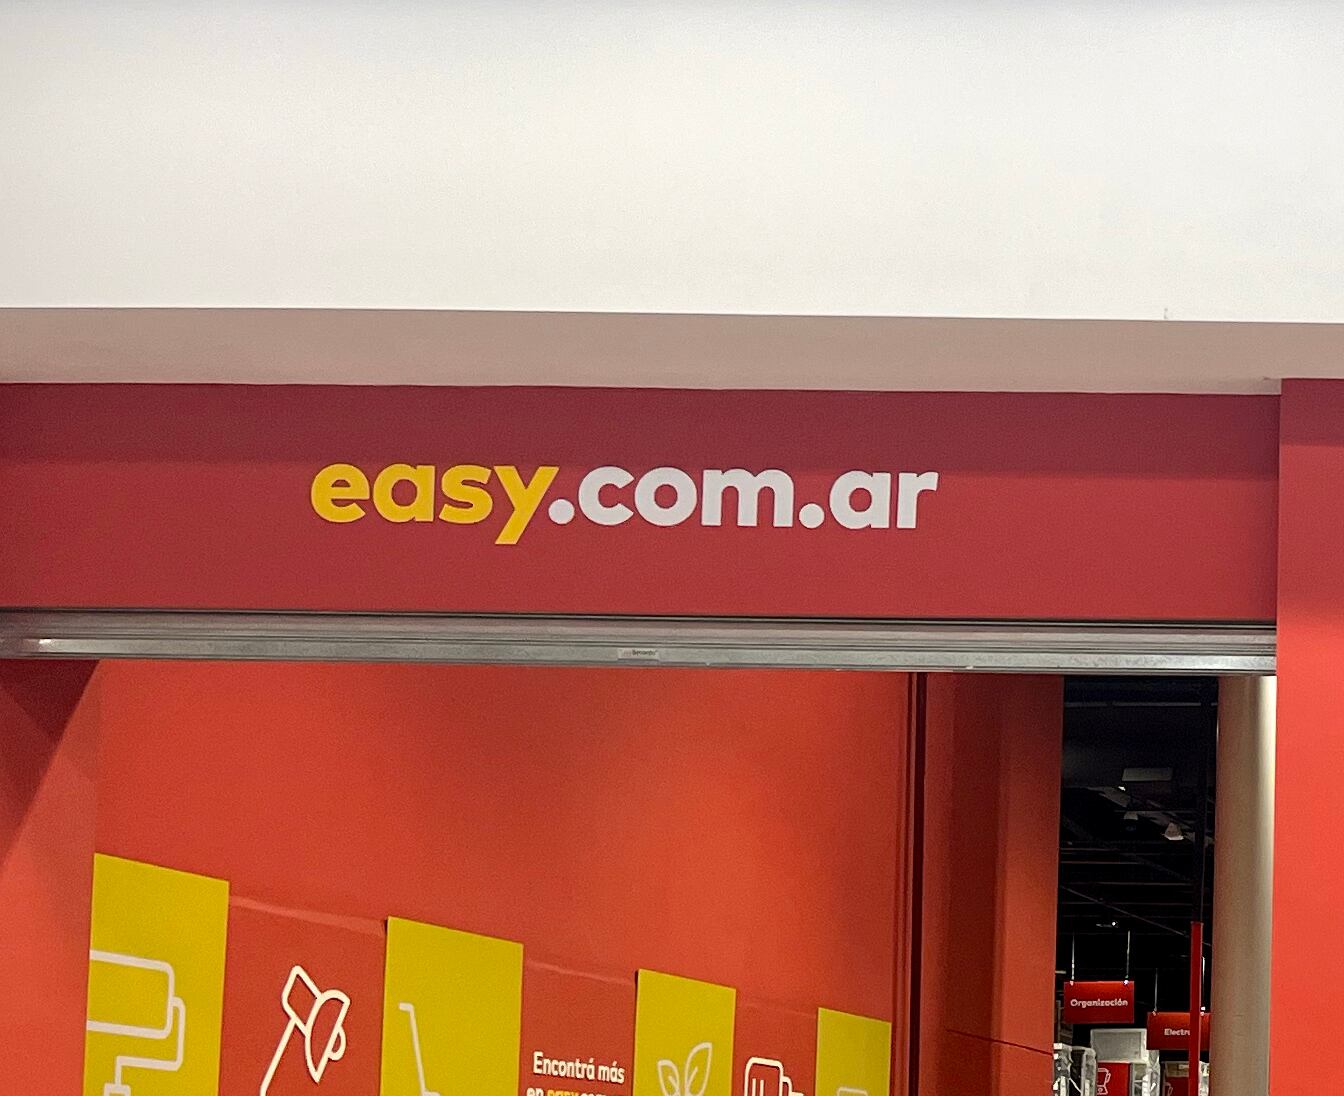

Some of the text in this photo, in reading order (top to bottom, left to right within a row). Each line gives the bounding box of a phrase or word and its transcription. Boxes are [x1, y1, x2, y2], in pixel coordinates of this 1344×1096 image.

[310, 463, 939, 545] easy.com.ar
[1070, 998, 1129, 1009] Organización
[1163, 1028, 1190, 1036] Electr
[533, 1051, 625, 1084] Encontrá más
